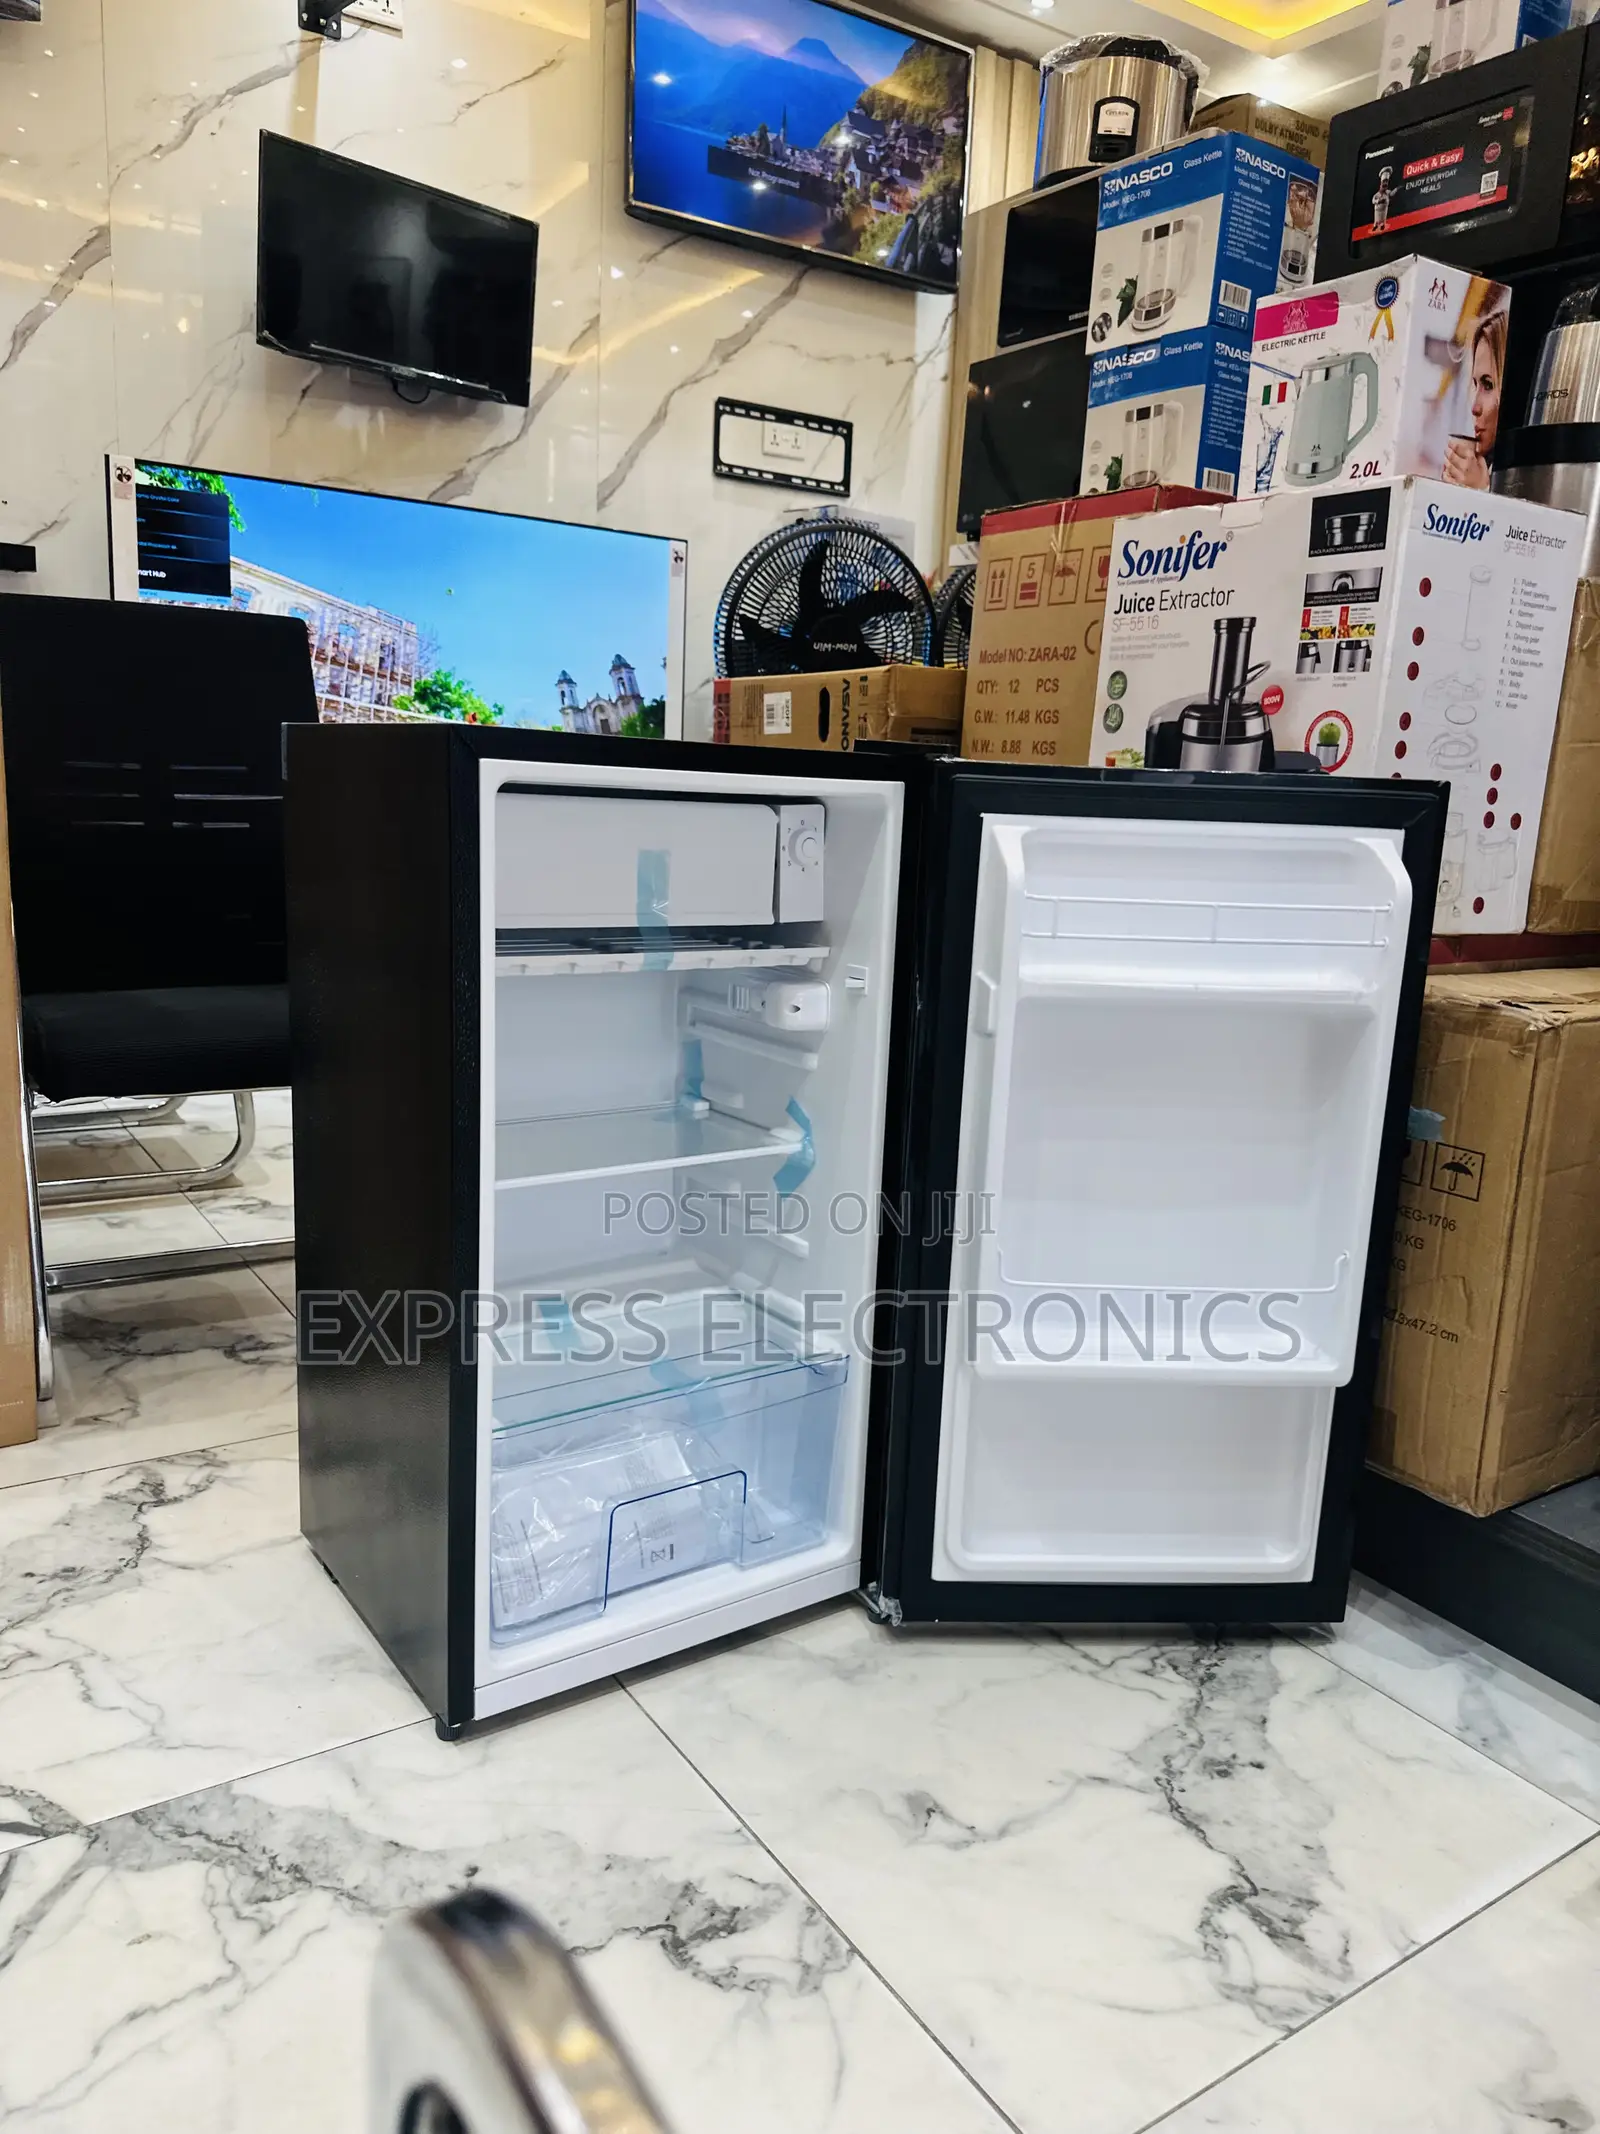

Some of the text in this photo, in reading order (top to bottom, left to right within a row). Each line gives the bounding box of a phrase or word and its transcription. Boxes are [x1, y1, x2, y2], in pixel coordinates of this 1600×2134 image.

[1244, 152, 1286, 179] NASCO
[1406, 151, 1462, 176] Quick & Easy
[1115, 161, 1174, 192] NASCO
[1183, 157, 1203, 169] Glass
[1405, 168, 1458, 191] ENJOY EVERYDAY
[1419, 183, 1442, 195] MEALS
[1427, 298, 1447, 312] ZARA
[1261, 331, 1326, 352] ELECTRIC KETTLE
[1102, 348, 1157, 372] NASCO
[1163, 347, 1182, 357] Glass
[1224, 345, 1251, 362] NAS
[1350, 461, 1381, 479] 2.0L
[1423, 503, 1490, 544] Sonifer
[1505, 524, 1567, 550] Juice Extractor
[1117, 530, 1228, 582] Sonifer
[153, 569, 167, 579] Hub
[1026, 562, 1035, 579] 5
[1114, 586, 1235, 615] Juice Extractor
[1112, 614, 1160, 633] SF-5516
[979, 646, 1077, 664] Model NO: ZARA-02
[977, 678, 1060, 694] QTY: 12 PCS
[974, 709, 1060, 725] G.W.: 11.48 KGS
[971, 740, 1057, 756] N.W.: 8.88 KGS
[1404, 1234, 1425, 1250] KG
[1440, 1328, 1459, 1344] cm
